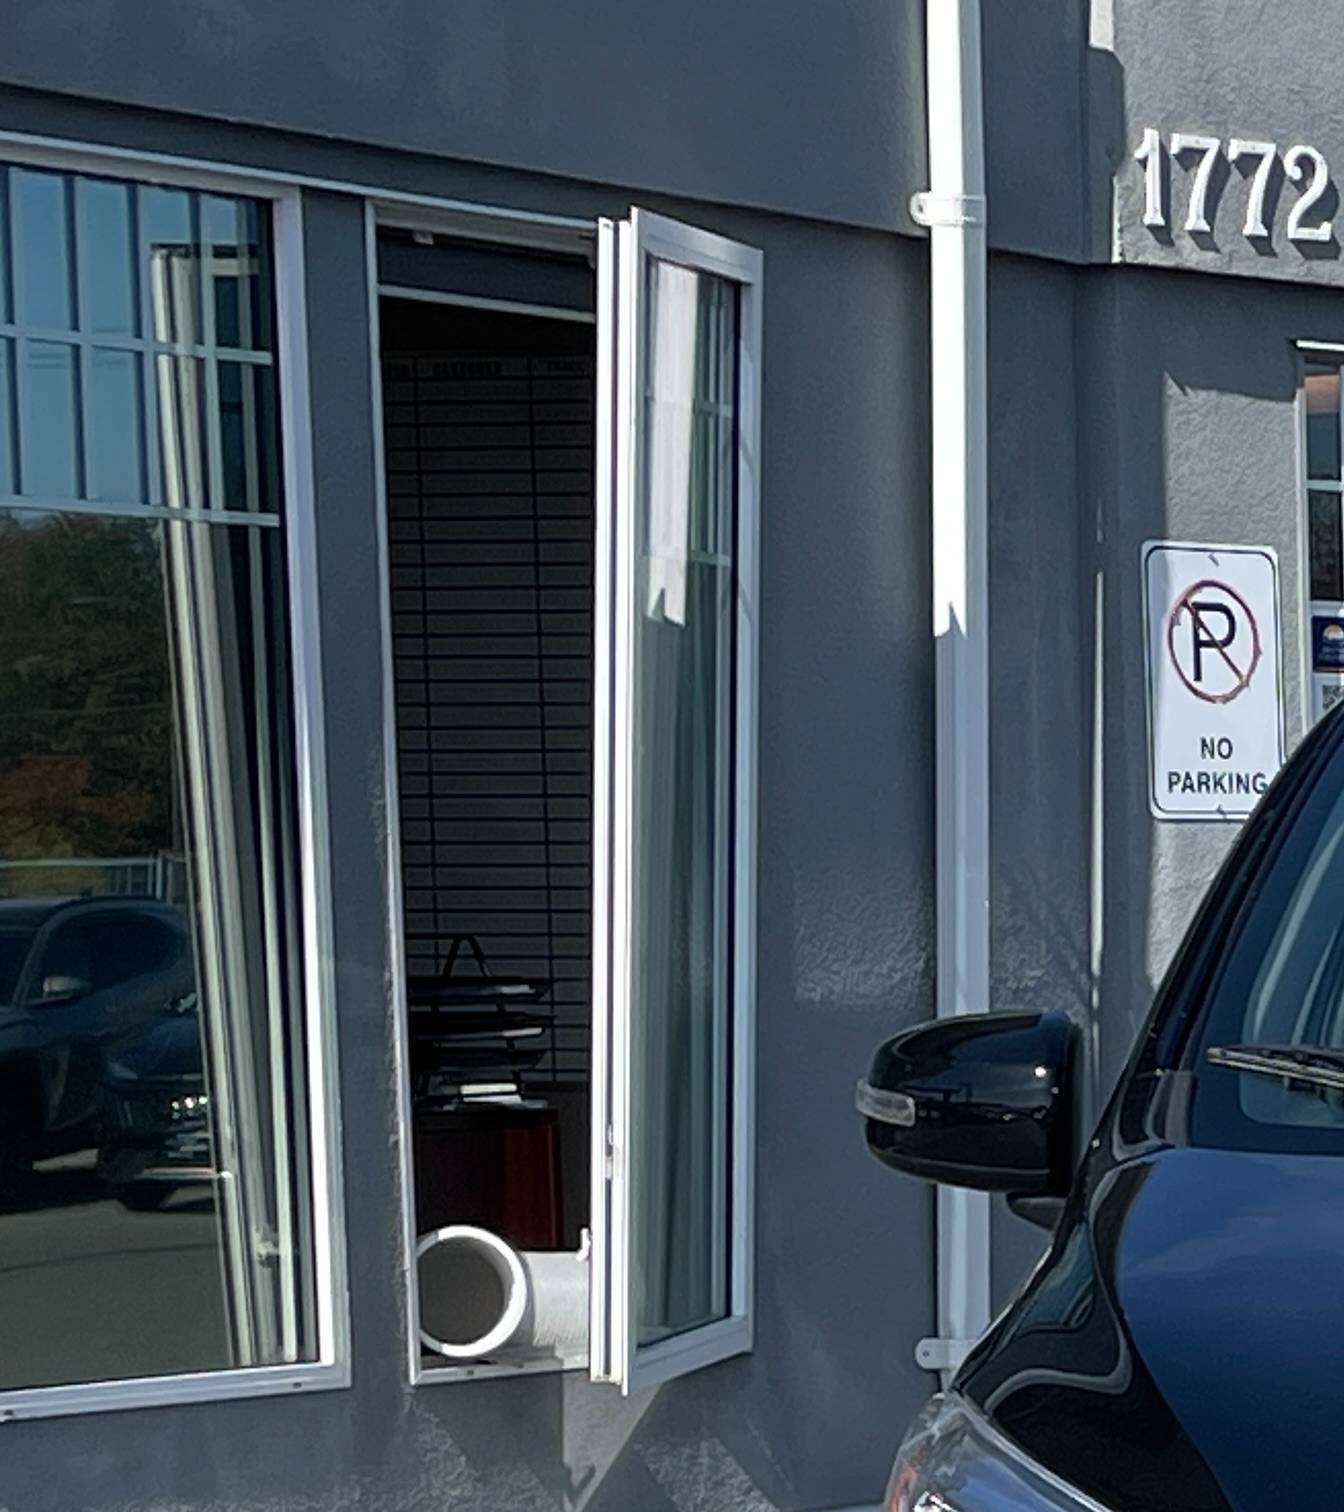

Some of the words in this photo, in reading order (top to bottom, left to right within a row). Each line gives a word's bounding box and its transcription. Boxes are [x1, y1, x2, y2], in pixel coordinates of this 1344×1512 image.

[1134, 127, 1333, 241] 1772
[1200, 737, 1233, 760] NO
[1168, 772, 1267, 794] PARKING
